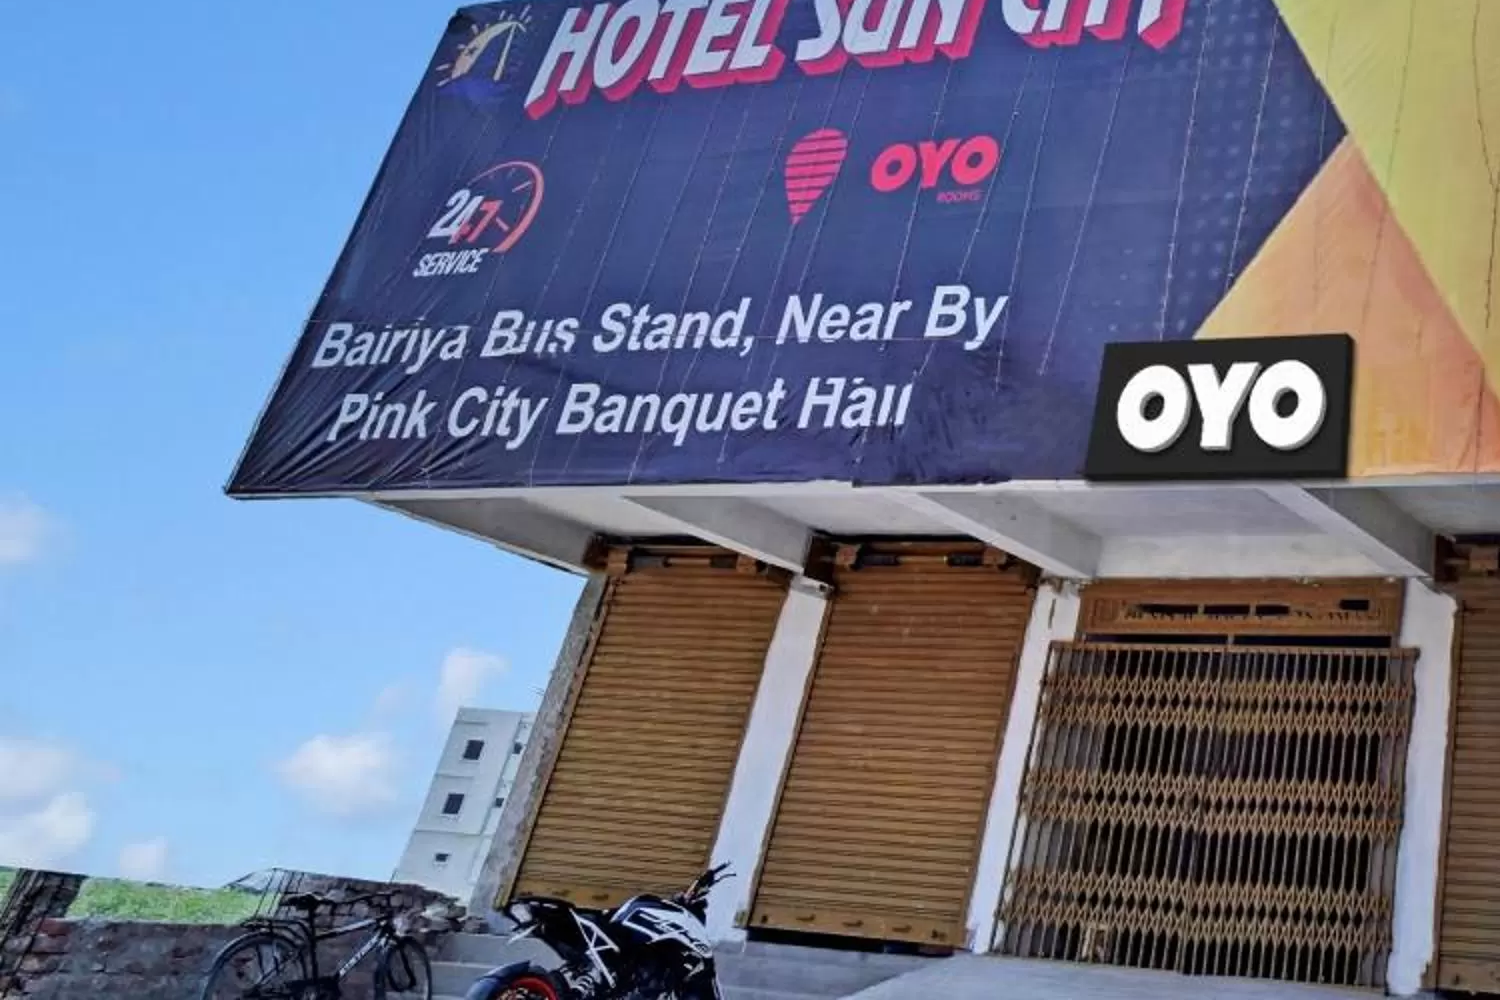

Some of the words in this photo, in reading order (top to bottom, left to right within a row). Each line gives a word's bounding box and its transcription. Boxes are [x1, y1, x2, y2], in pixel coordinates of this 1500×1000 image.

[870, 135, 1000, 193] OYO
[412, 247, 490, 277] SERVICE
[312, 317, 471, 375] Bairiya
[480, 309, 580, 358] Bus
[592, 297, 755, 357] Stand,
[775, 293, 913, 345] Near
[923, 284, 1009, 350] By
[326, 388, 437, 442] Pink
[447, 384, 549, 450] City
[555, 377, 787, 447] Banquet
[797, 376, 913, 430] Hall
[1116, 359, 1327, 453] OYO
